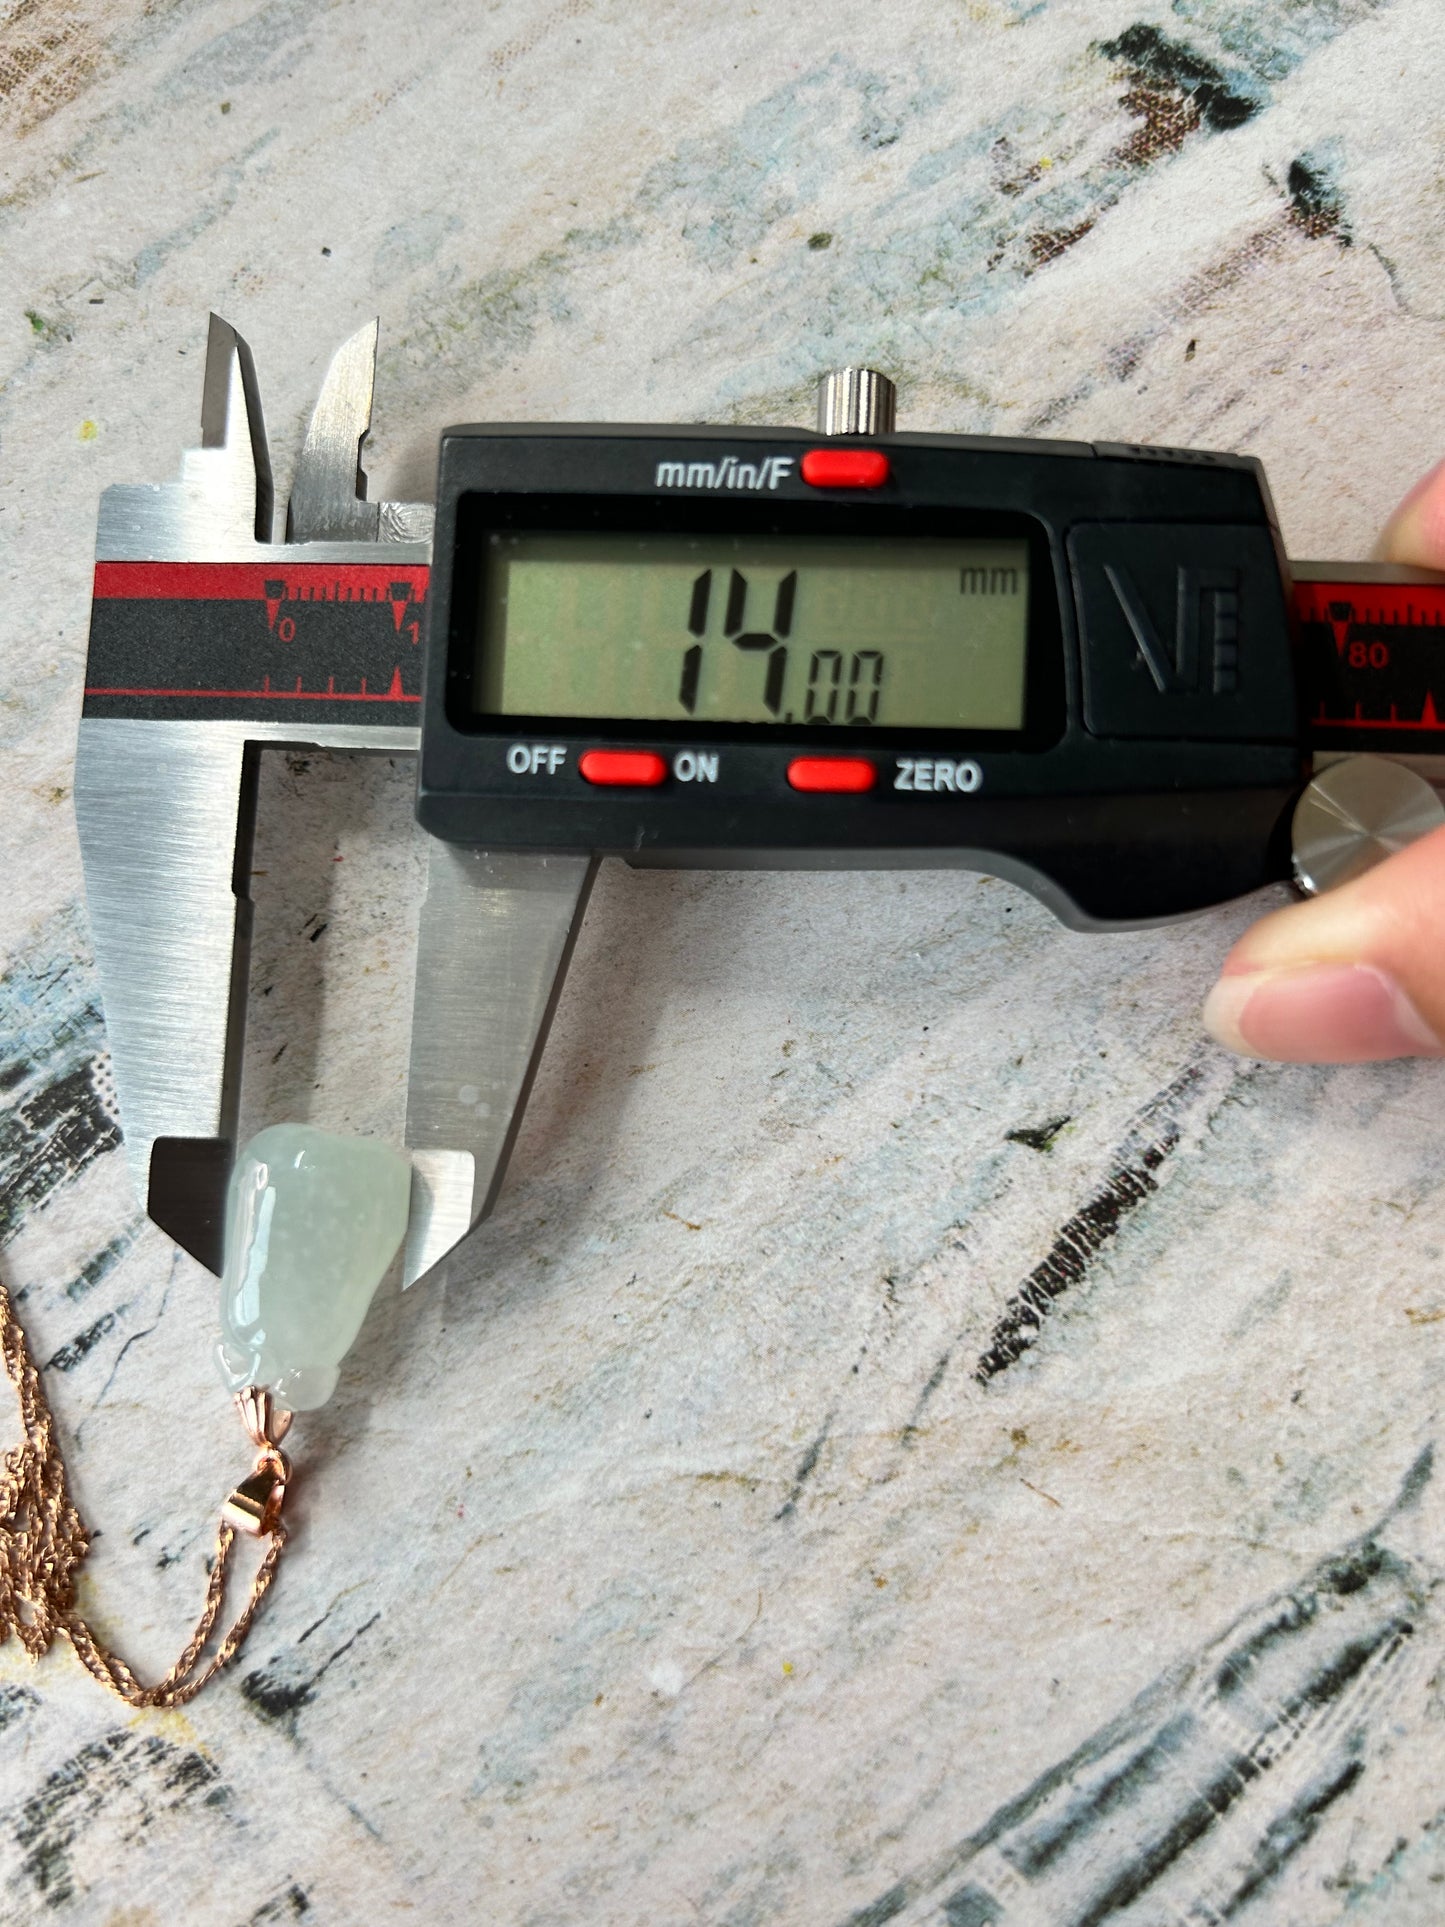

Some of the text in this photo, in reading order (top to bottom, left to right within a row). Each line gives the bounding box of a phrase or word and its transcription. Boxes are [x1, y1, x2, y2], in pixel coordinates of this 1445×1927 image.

[655, 457, 795, 491] mm/in/F
[958, 567, 1018, 595] mm
[279, 618, 296, 642] 0
[678, 568, 884, 725] 14.00
[1349, 642, 1389, 669] 80
[507, 745, 568, 775] OFF
[674, 750, 720, 783] ON
[894, 757, 984, 794] ZERO
